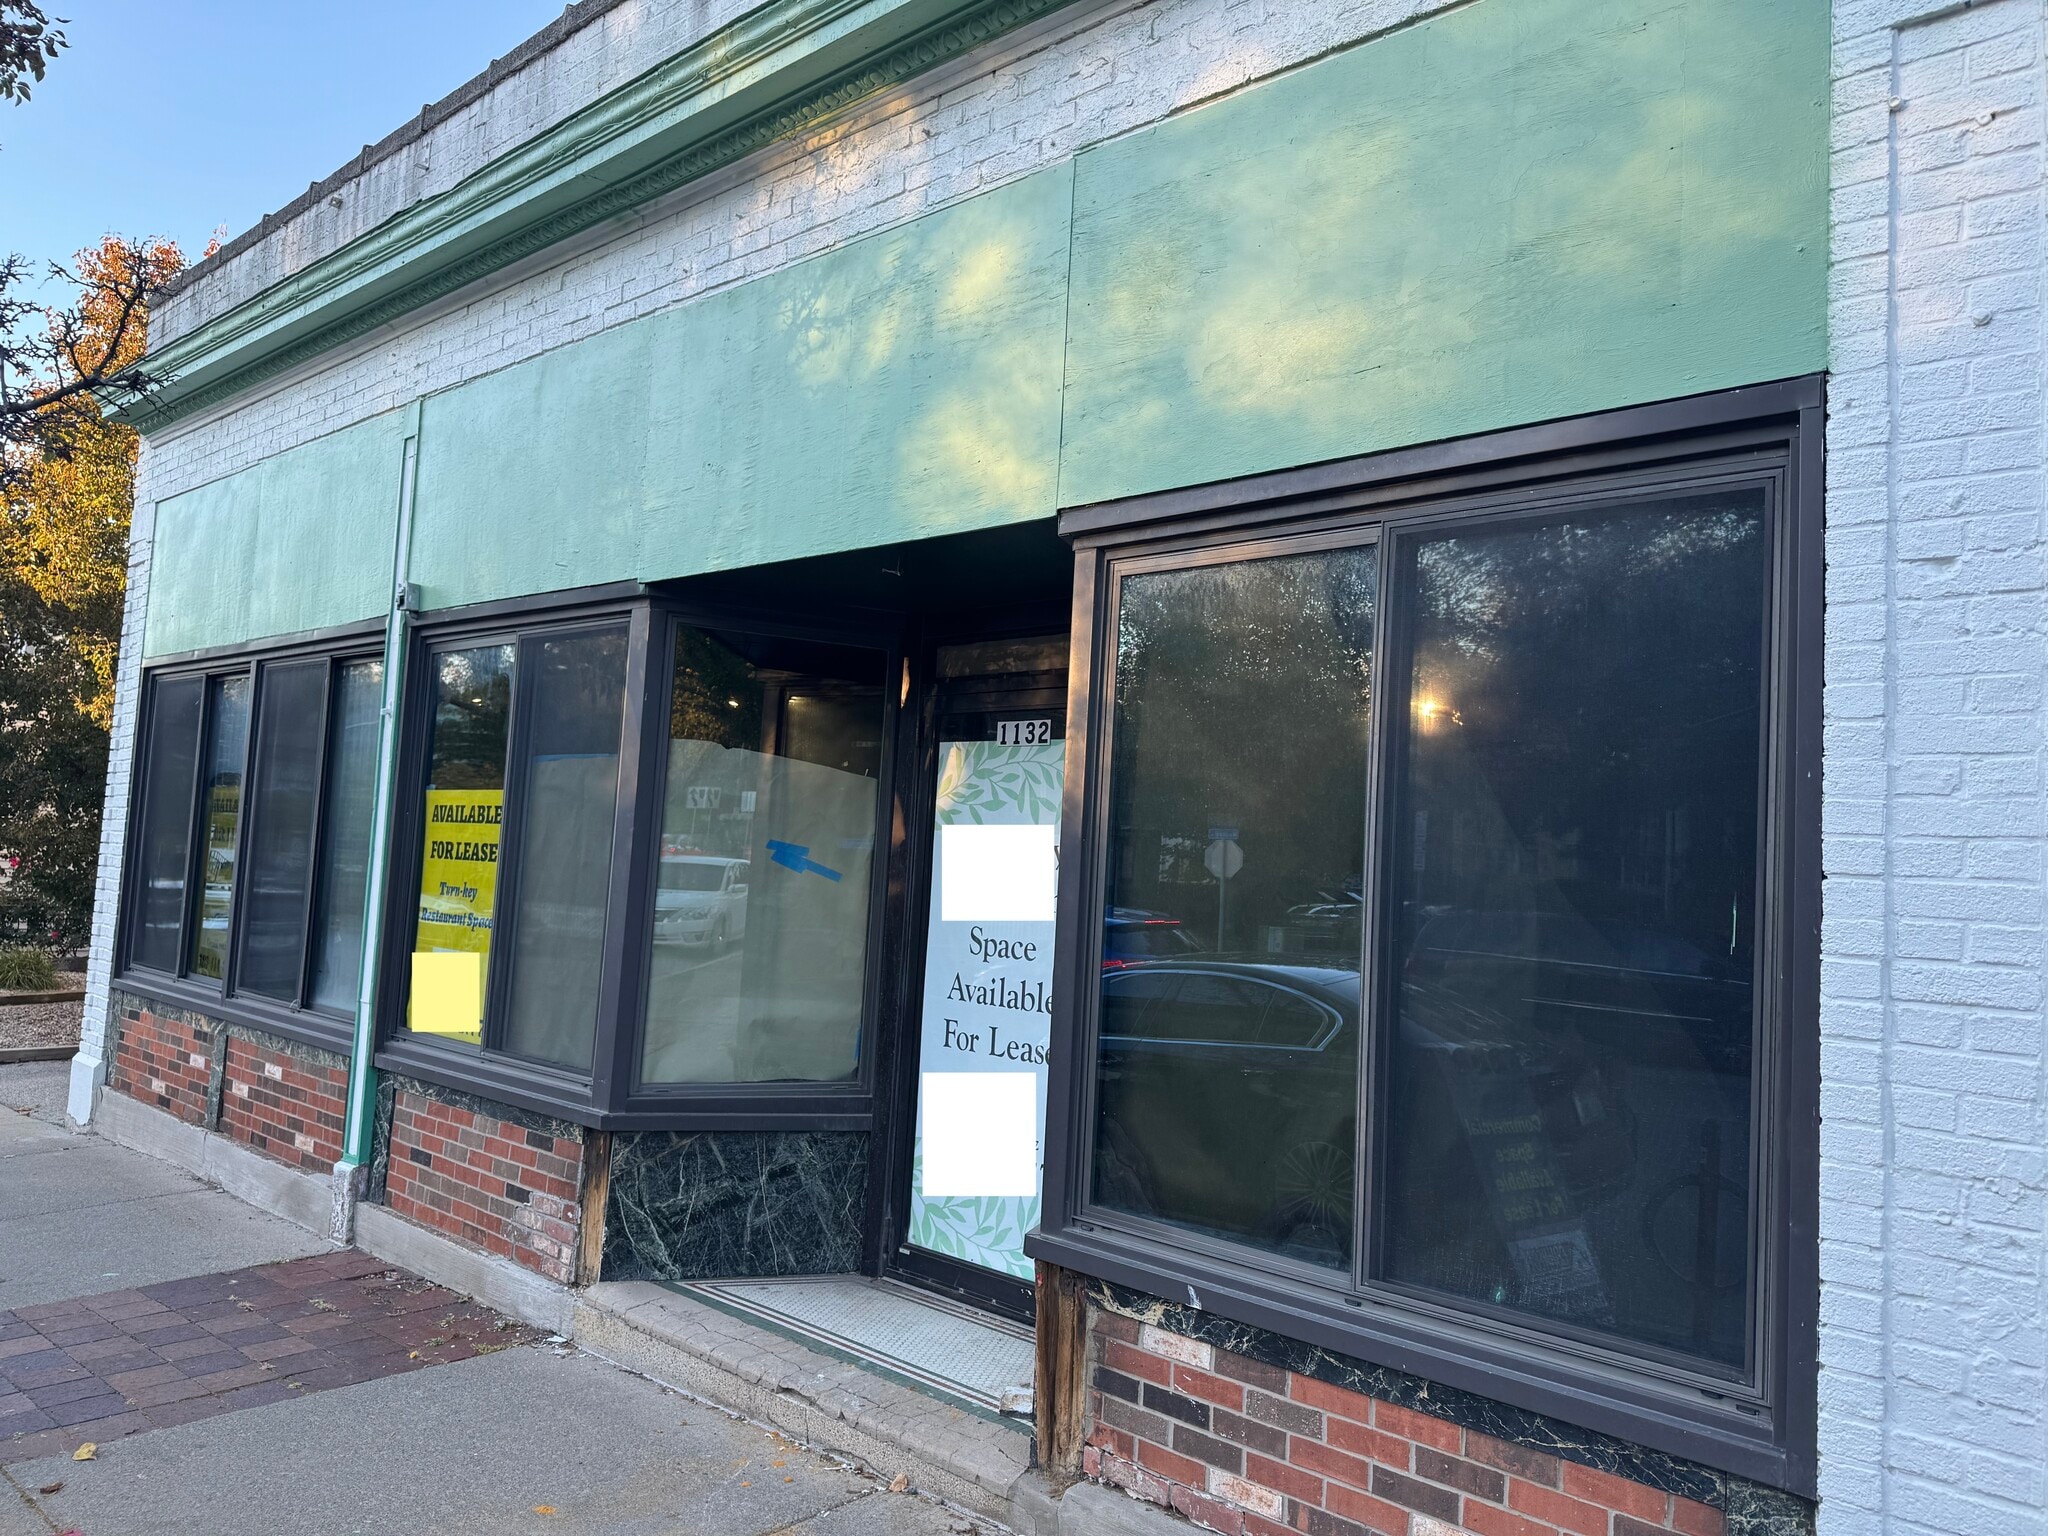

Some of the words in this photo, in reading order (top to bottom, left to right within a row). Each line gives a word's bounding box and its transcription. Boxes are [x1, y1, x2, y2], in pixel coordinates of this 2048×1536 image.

[999, 721, 1049, 745] 1132
[432, 804, 502, 824] AVAILABLE
[430, 840, 454, 860] FOR
[455, 842, 498, 862] LEASE
[422, 908, 467, 925] Restaurant
[467, 912, 493, 931] Space
[969, 925, 1037, 963] Space
[947, 972, 1053, 1015] Available
[943, 1018, 980, 1053] For
